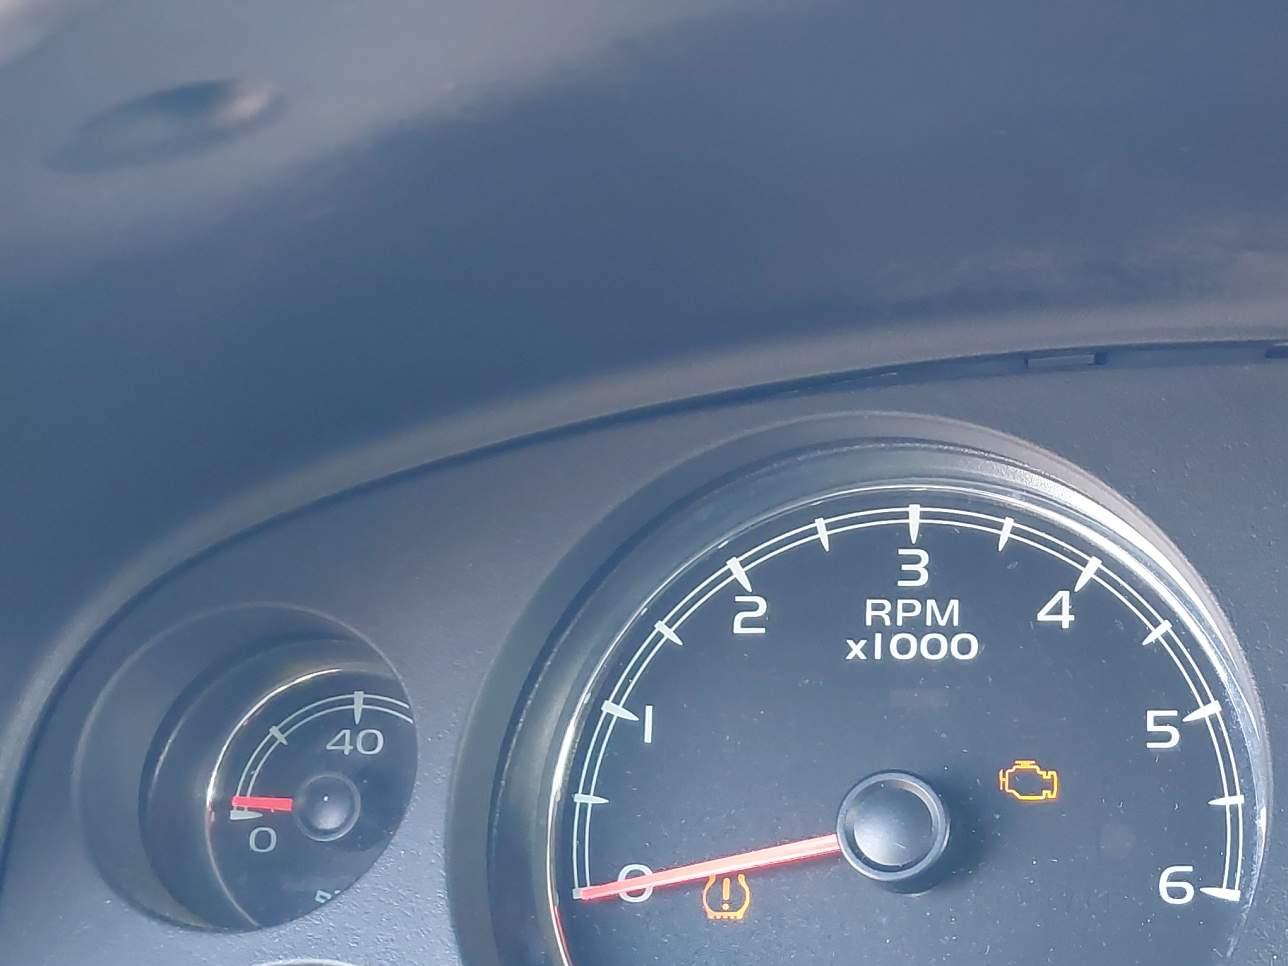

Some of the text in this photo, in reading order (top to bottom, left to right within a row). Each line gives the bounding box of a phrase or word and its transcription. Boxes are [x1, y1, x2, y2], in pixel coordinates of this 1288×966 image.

[897, 548, 930, 587] 3
[733, 595, 768, 634] 2
[865, 599, 959, 627] RPM
[1036, 590, 1076, 629] 4
[845, 632, 979, 660] x1000
[325, 729, 384, 756] 40
[643, 705, 653, 744] 1
[1146, 710, 1181, 749] 5
[249, 826, 277, 853] 0
[617, 863, 654, 903] 0
[1158, 865, 1195, 905] 6
